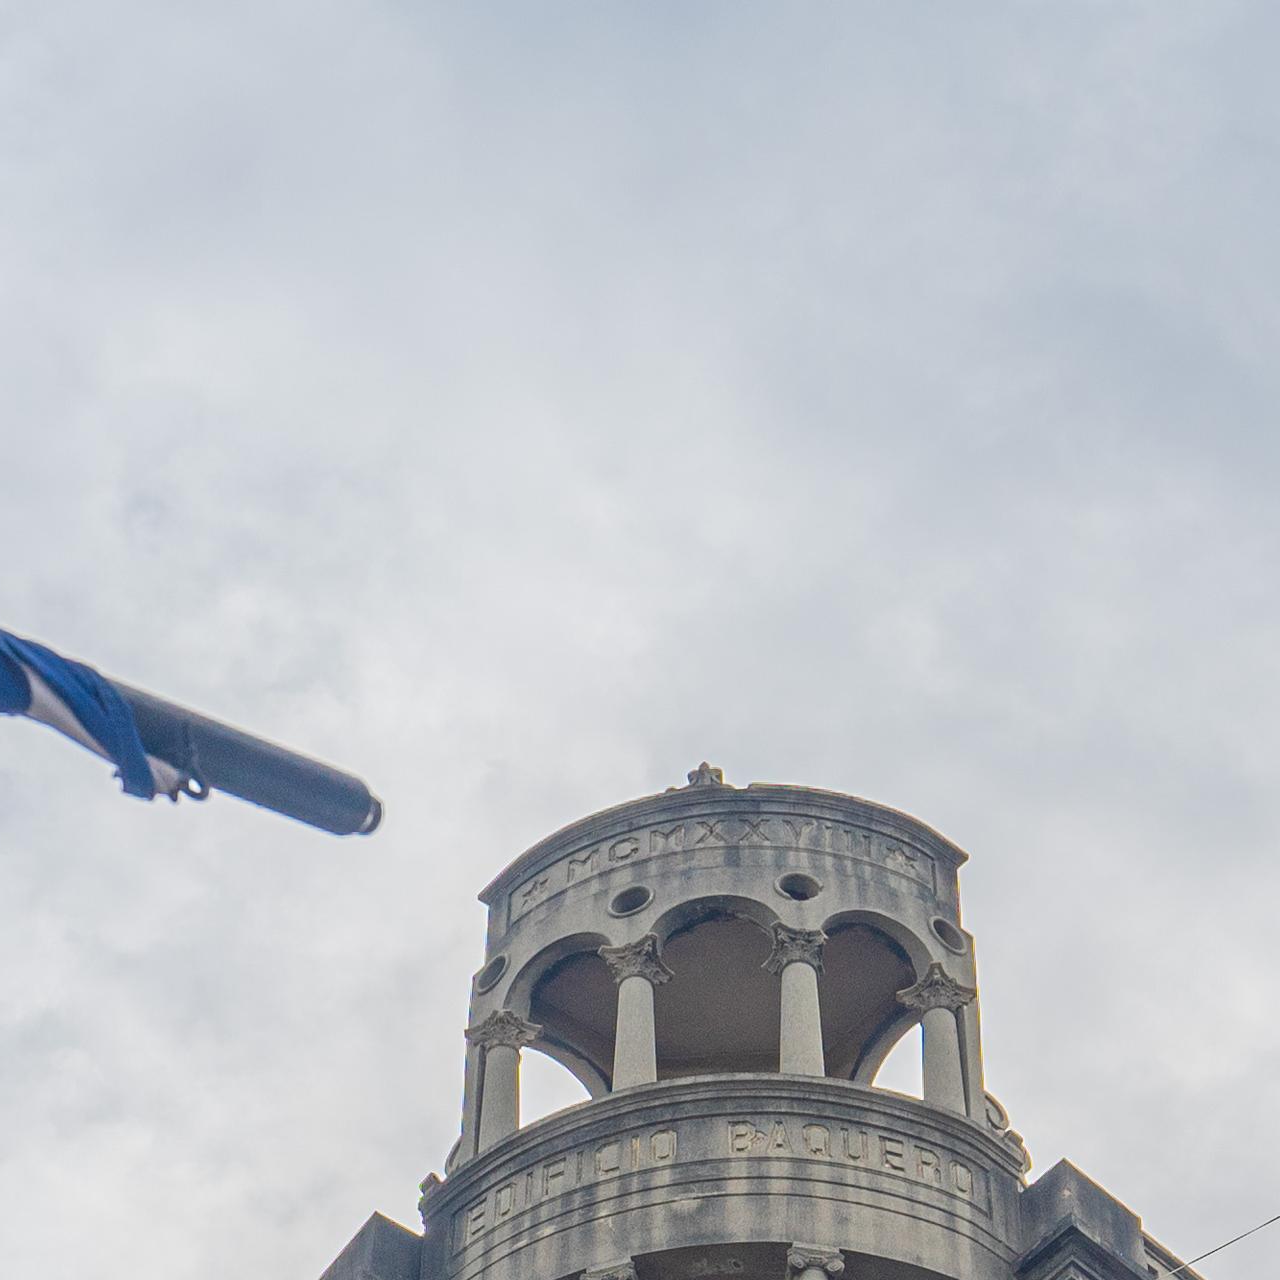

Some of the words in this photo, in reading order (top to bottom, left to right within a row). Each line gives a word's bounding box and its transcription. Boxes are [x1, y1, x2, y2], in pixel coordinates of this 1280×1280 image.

[567, 819, 872, 882] MCMXXVIII
[465, 1128, 678, 1243] EDIFICIO
[727, 1120, 974, 1197] BAQUERO
